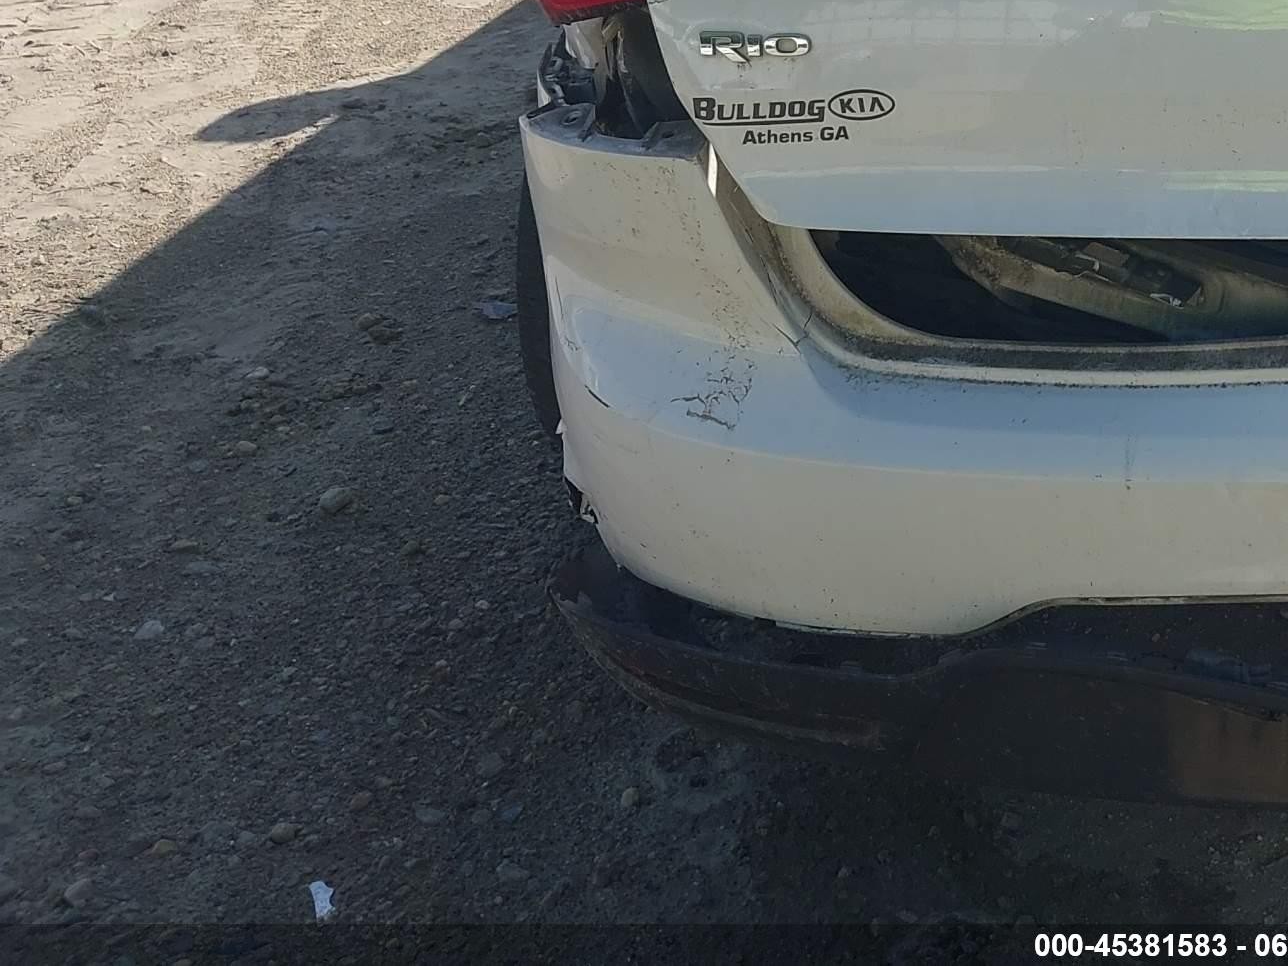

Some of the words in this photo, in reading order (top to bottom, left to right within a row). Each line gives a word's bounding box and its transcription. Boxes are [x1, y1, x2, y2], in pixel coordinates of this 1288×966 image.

[692, 97, 826, 123] BULLDOG
[838, 96, 887, 114] KIA
[742, 130, 813, 145] Athens
[820, 126, 849, 141] GA
